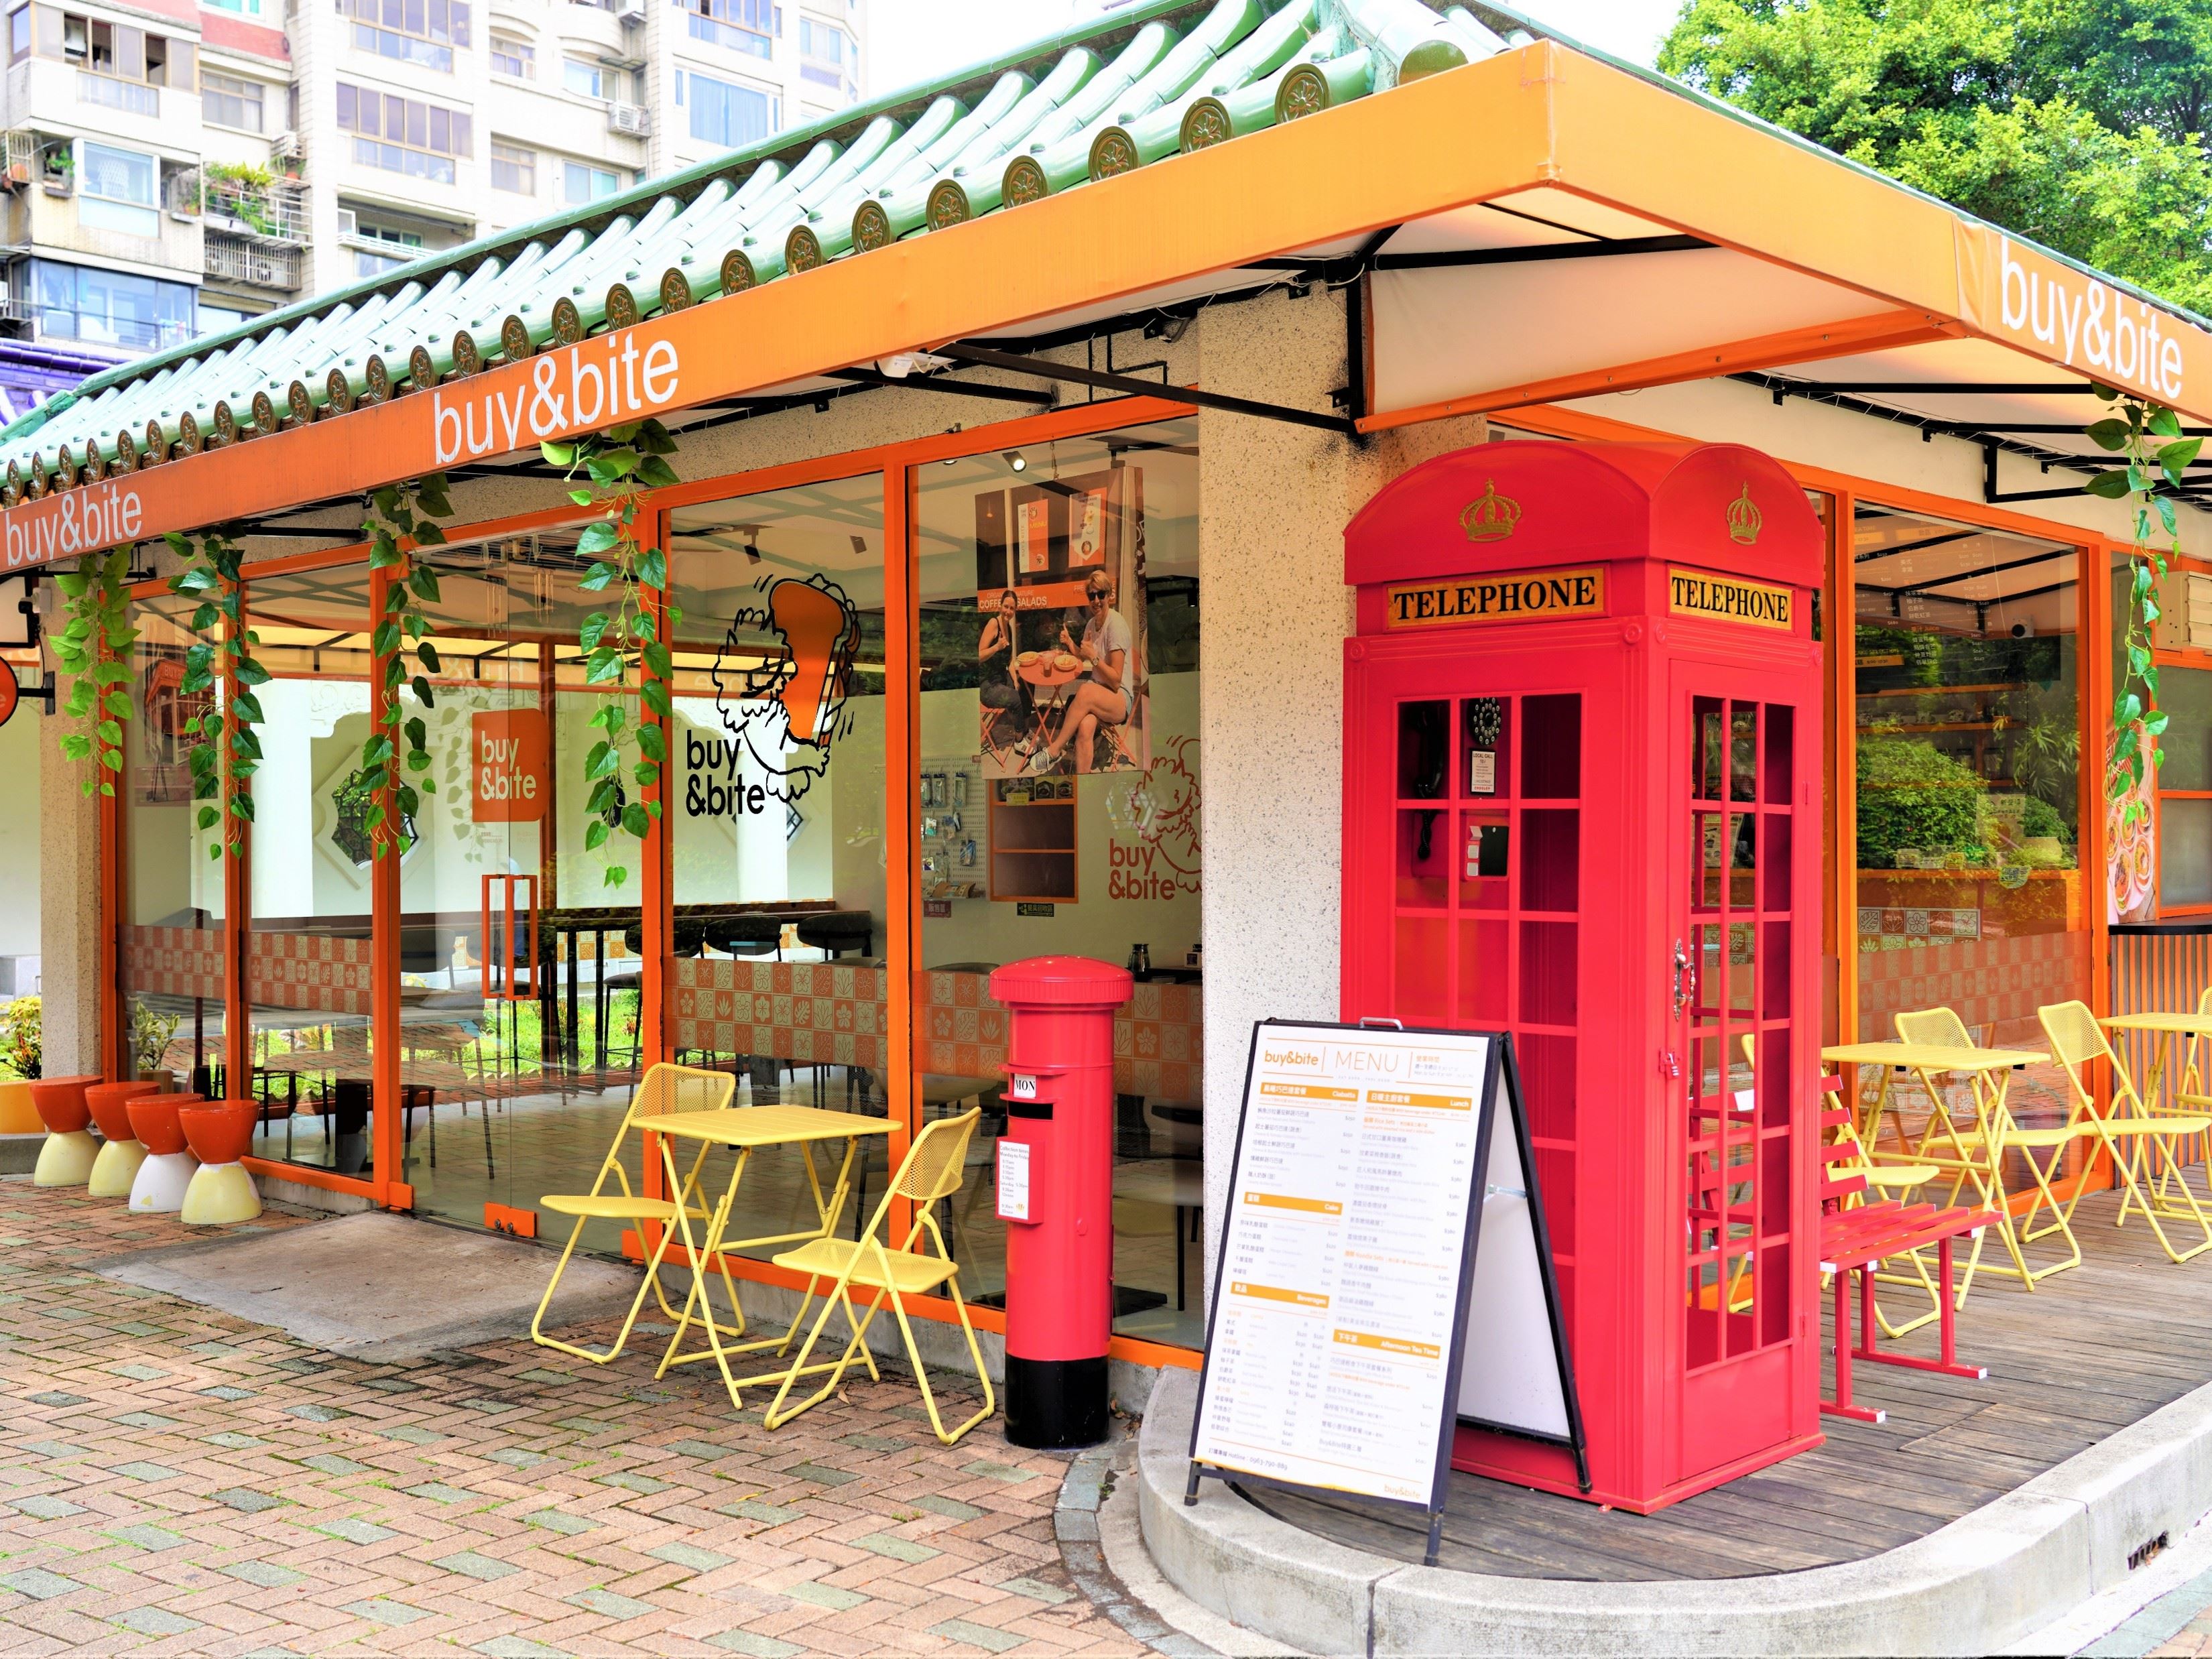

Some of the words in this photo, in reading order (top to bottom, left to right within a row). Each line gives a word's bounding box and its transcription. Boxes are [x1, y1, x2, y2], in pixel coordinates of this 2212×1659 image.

[2001, 235, 2184, 399] buy&bite
[434, 332, 679, 465] buy&bite
[5, 484, 142, 566] buy&bite
[979, 600, 1002, 609] COFFE
[1017, 596, 1048, 606] SALADS
[1394, 576, 1596, 620] TELEPHONE
[1670, 576, 1789, 623] TELEPHONE
[481, 730, 520, 773] buy
[686, 729, 741, 780] buy
[480, 767, 537, 801] &bite
[685, 774, 765, 817] &bite
[1109, 838, 1156, 876] buy
[1108, 870, 1176, 900] &bite
[1264, 1049, 1319, 1068] buy&bite
[1335, 1050, 1398, 1072] MENU
[1015, 1079, 1035, 1091] MON
[1296, 1294, 1326, 1305] Beverages
[1337, 1333, 1357, 1343] 下午茶
[1380, 1341, 1410, 1351] Afternoon
[1423, 1348, 1438, 1356] Time
[1384, 1483, 1421, 1501] buy&bite
